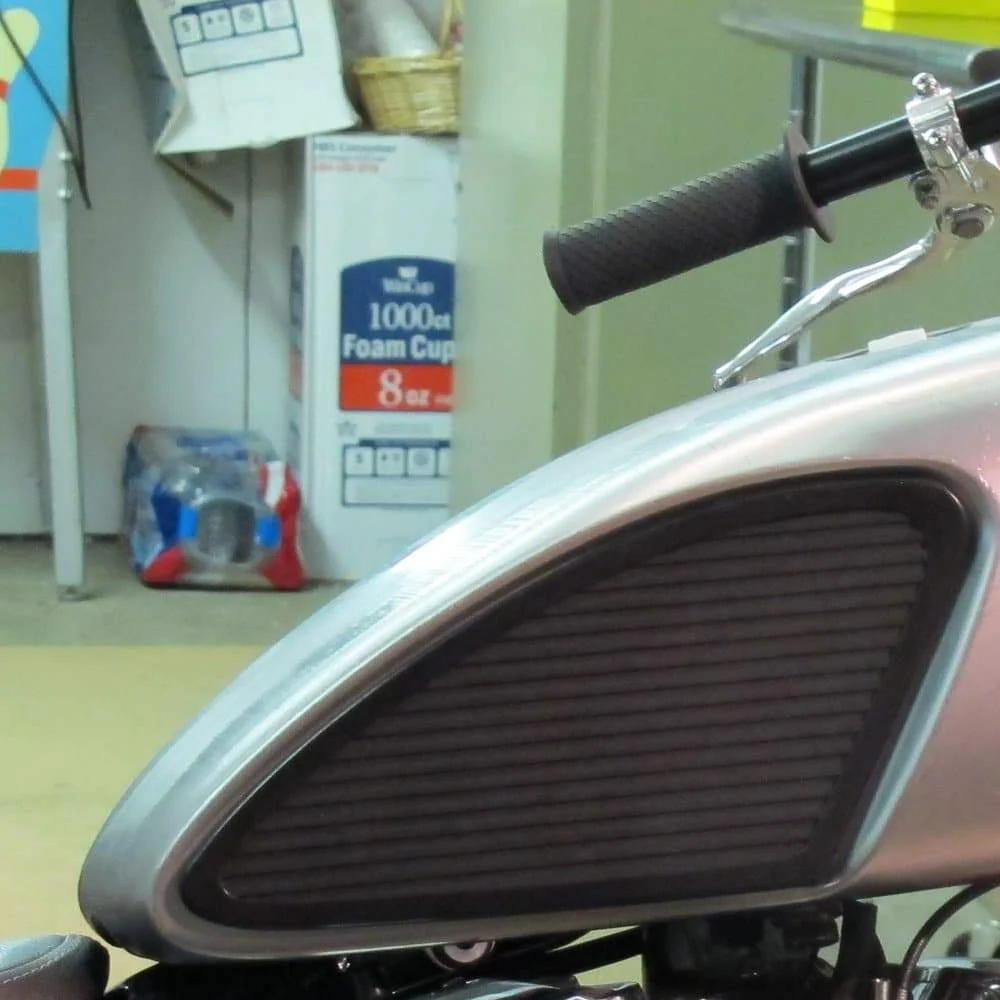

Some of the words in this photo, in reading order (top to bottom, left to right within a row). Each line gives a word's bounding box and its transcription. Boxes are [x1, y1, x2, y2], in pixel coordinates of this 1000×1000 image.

[343, 333, 406, 359] Foam
[379, 368, 403, 408] 8
[405, 388, 430, 406] oz
